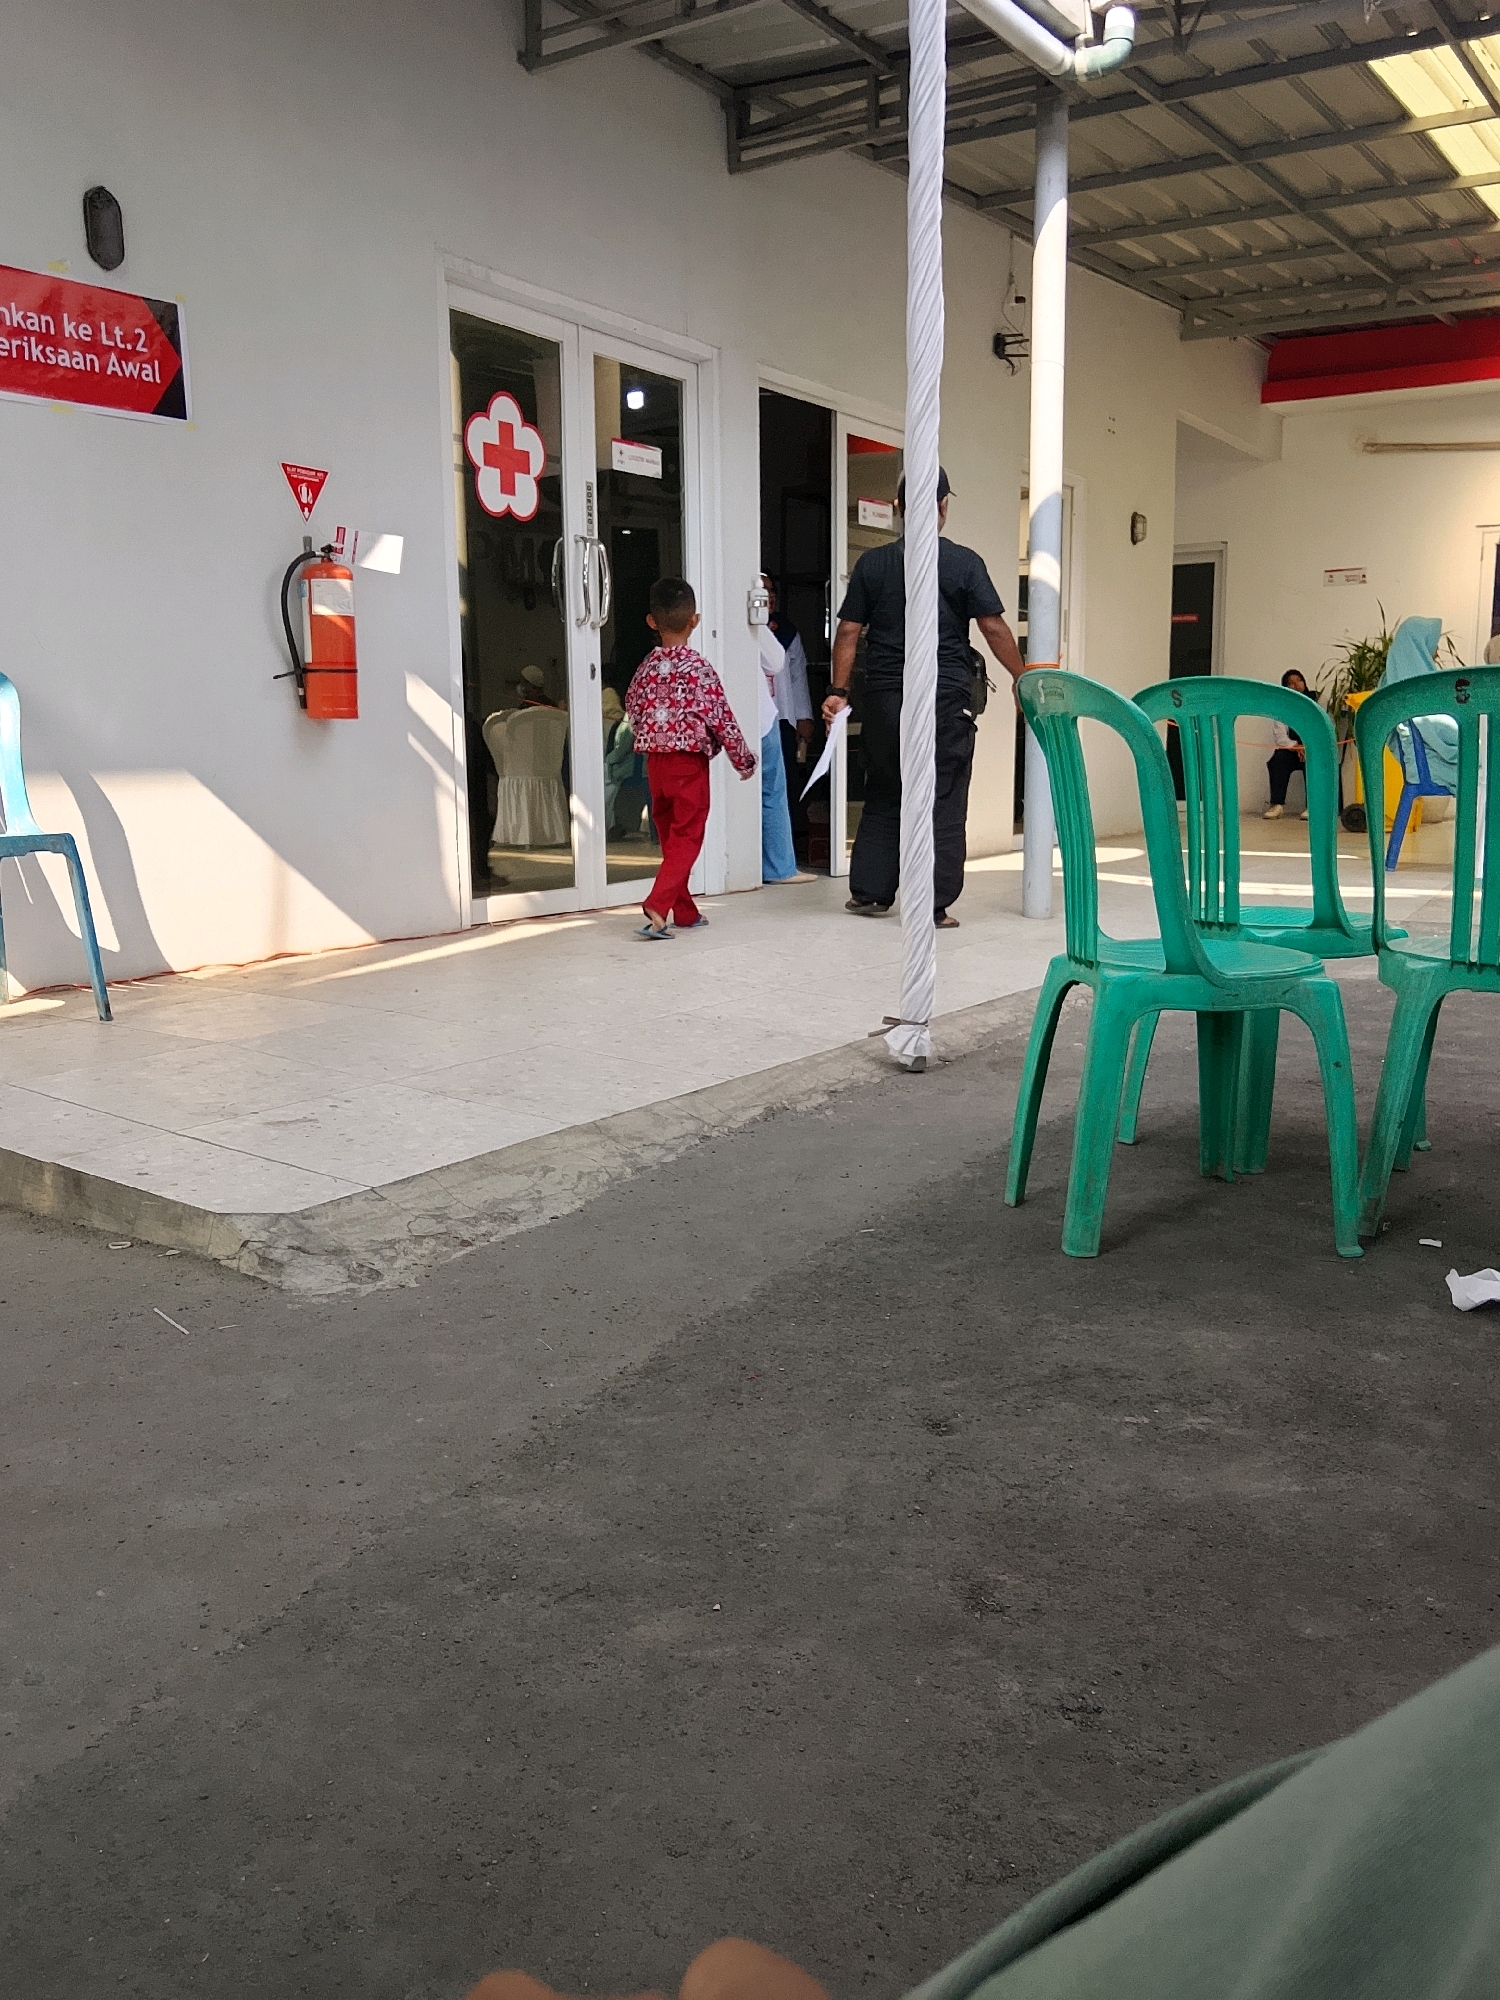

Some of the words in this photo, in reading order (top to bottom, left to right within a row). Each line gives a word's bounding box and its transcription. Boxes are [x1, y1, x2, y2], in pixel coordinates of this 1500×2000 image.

[63, 313, 92, 342] ke
[100, 321, 148, 353] Lt.2
[0, 336, 100, 374] eriksaan
[106, 352, 161, 384] Awal
[1171, 689, 1183, 708] S
